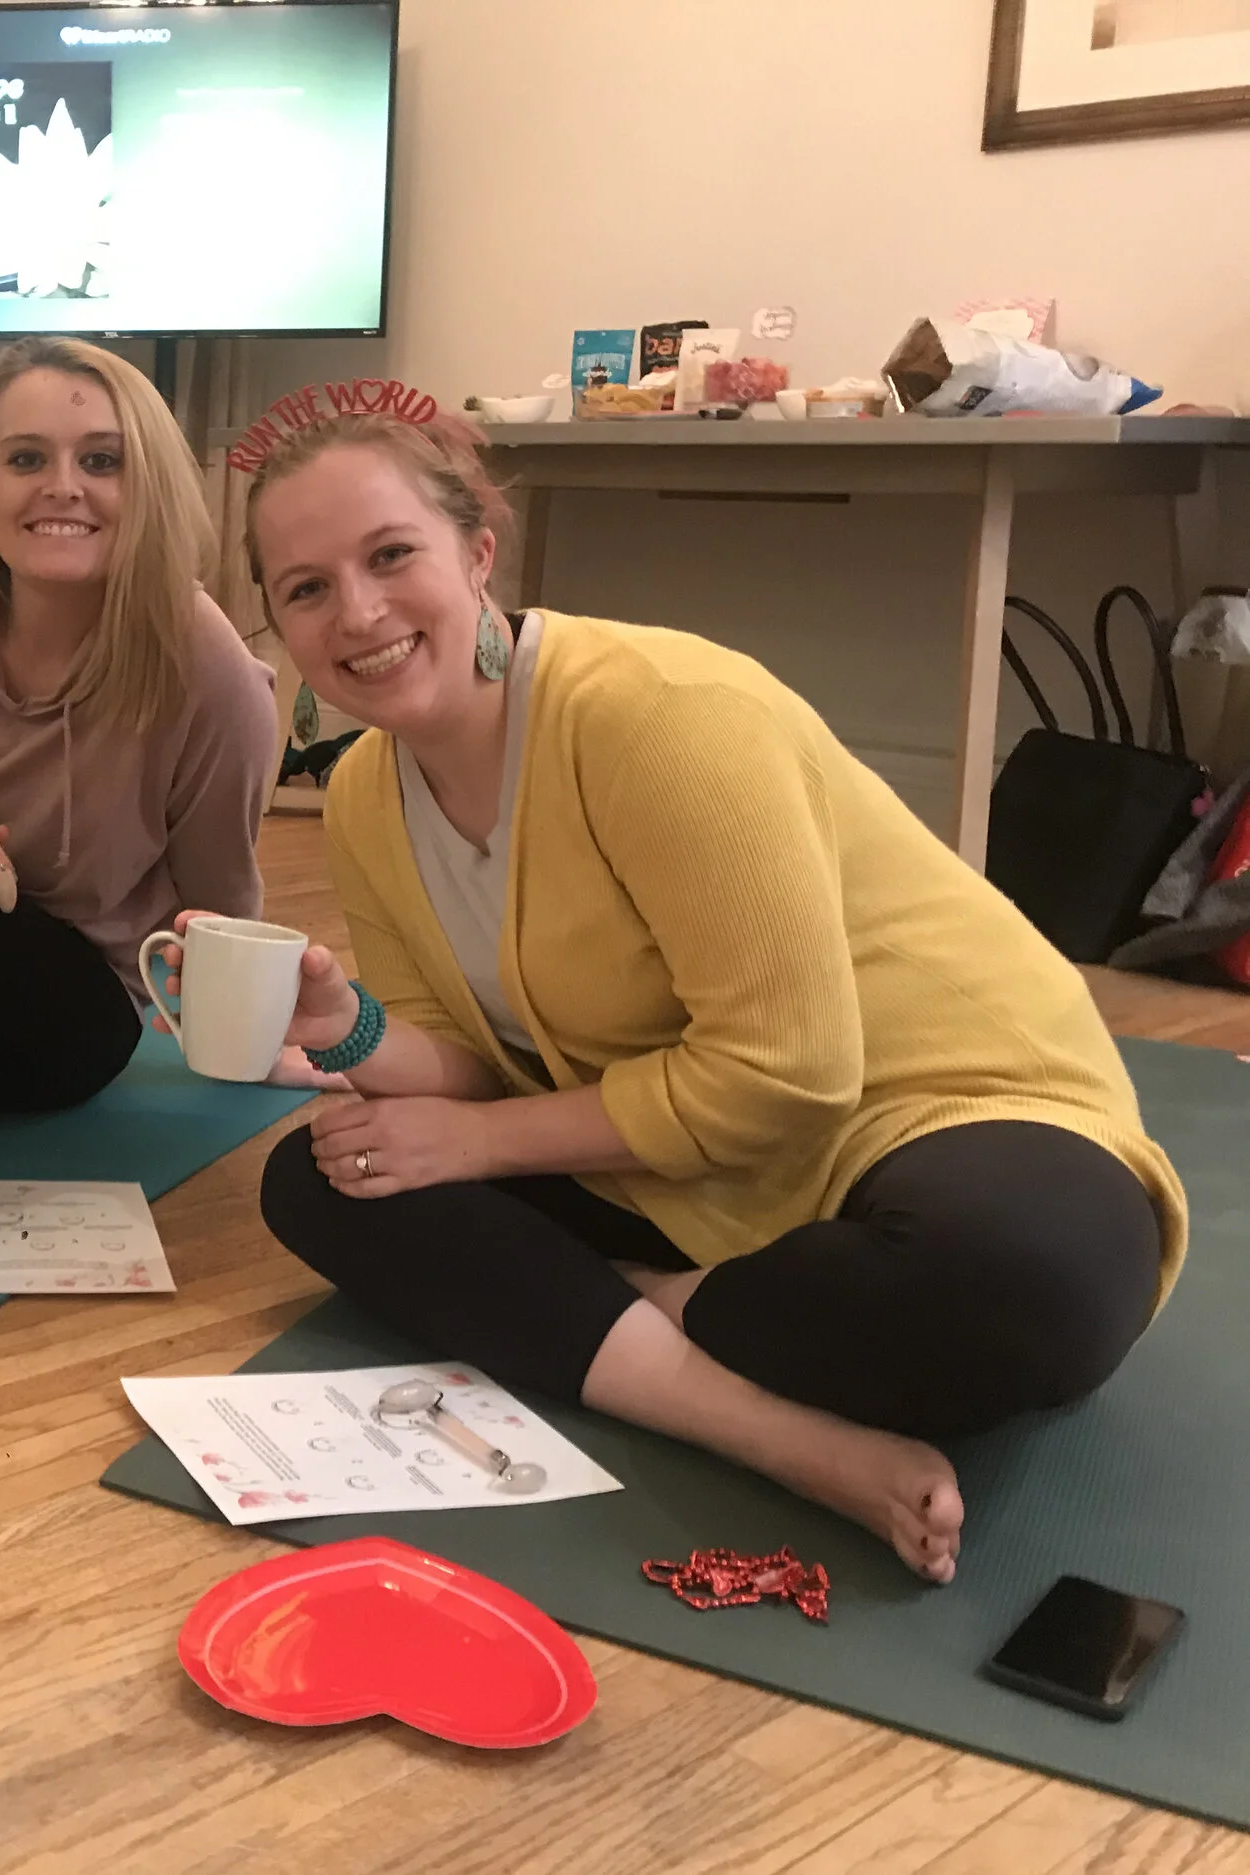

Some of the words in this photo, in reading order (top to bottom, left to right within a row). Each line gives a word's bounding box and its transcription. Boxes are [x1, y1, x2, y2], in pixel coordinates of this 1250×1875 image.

[645, 334, 683, 357] bar
[226, 416, 286, 473] RUN
[270, 384, 327, 432] THE
[325, 378, 438, 425] WORLD
